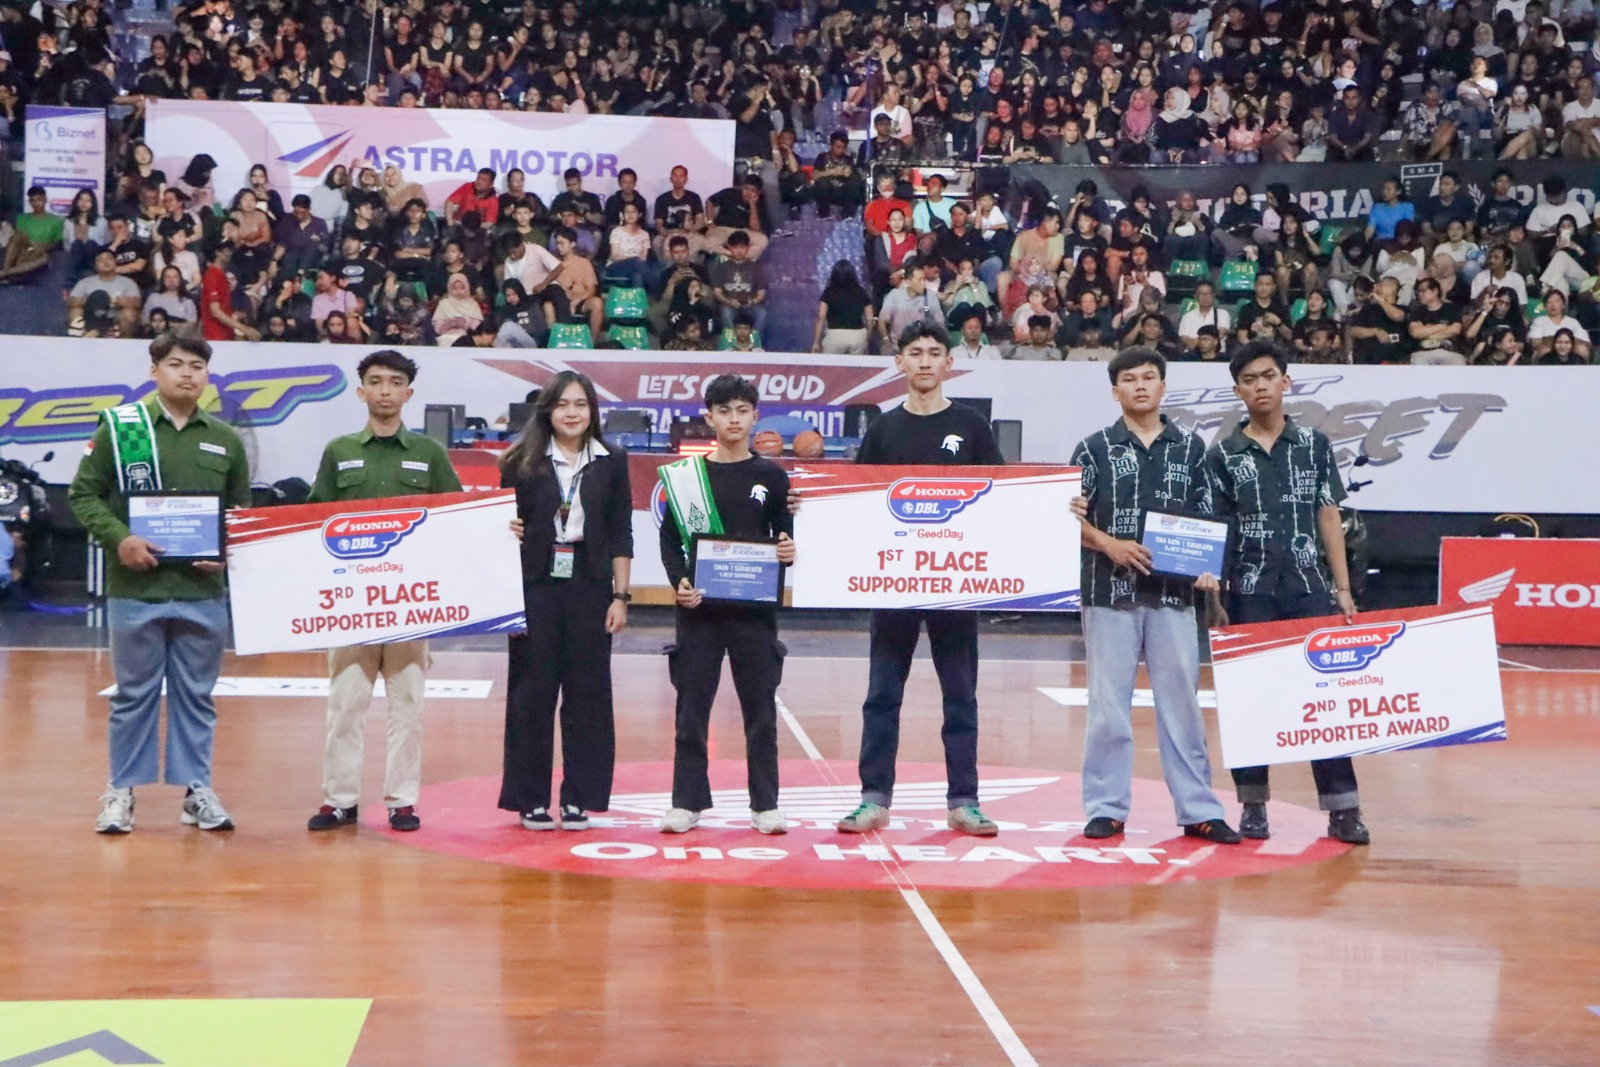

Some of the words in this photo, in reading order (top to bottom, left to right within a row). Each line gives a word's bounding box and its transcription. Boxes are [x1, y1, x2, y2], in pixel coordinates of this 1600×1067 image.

[57, 126, 97, 139] Biznet
[363, 145, 478, 173] ASTRA
[490, 148, 618, 178] MOTOR
[637, 374, 700, 400] LET'S
[915, 488, 967, 497] HONDA
[914, 502, 940, 514] DBL
[350, 520, 404, 532] HONDA
[351, 536, 378, 550] DBL
[877, 549, 904, 571] 1ST
[915, 551, 988, 572] PLACE
[847, 576, 953, 593] SUPPORTER
[959, 577, 1025, 594] AWARD
[319, 586, 354, 610] 3RD
[366, 581, 440, 606] PLACE
[1514, 583, 1600, 608] HO
[291, 611, 398, 635] SUPPORTER
[405, 605, 470, 626] AWARD
[1331, 634, 1383, 646] HONDA
[1332, 650, 1358, 664] DBL
[1302, 700, 1337, 723] 2ND
[1348, 692, 1421, 719] PLACE
[1276, 722, 1380, 748] SUPPORTER
[1386, 716, 1450, 737] AWARD
[570, 842, 789, 861] One
